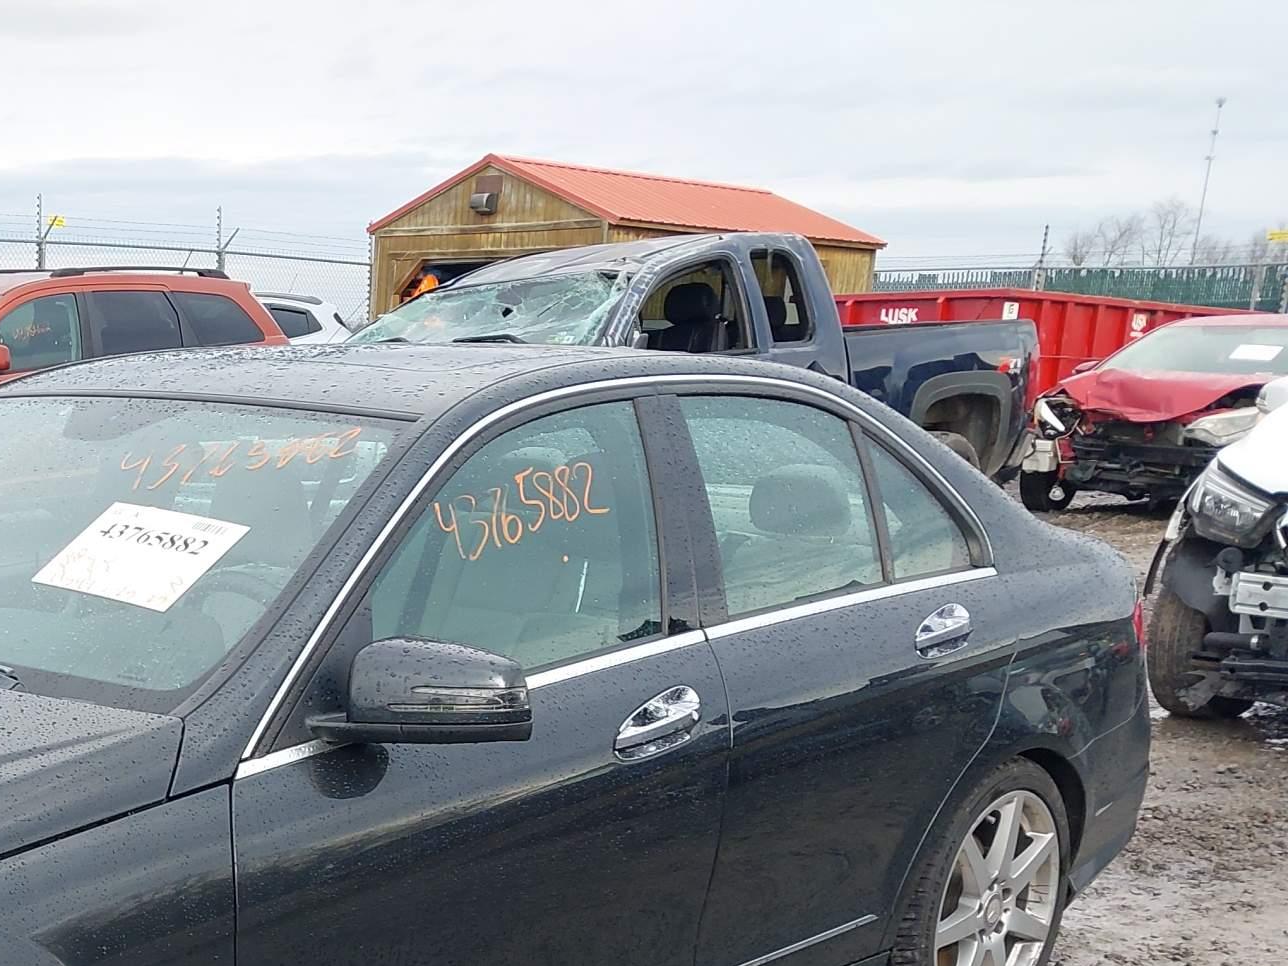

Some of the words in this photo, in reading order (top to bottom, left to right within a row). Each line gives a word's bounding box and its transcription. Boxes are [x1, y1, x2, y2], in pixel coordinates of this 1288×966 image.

[879, 307, 919, 325] LUSK
[433, 461, 610, 561] 43765882
[99, 522, 210, 556] 43765882
